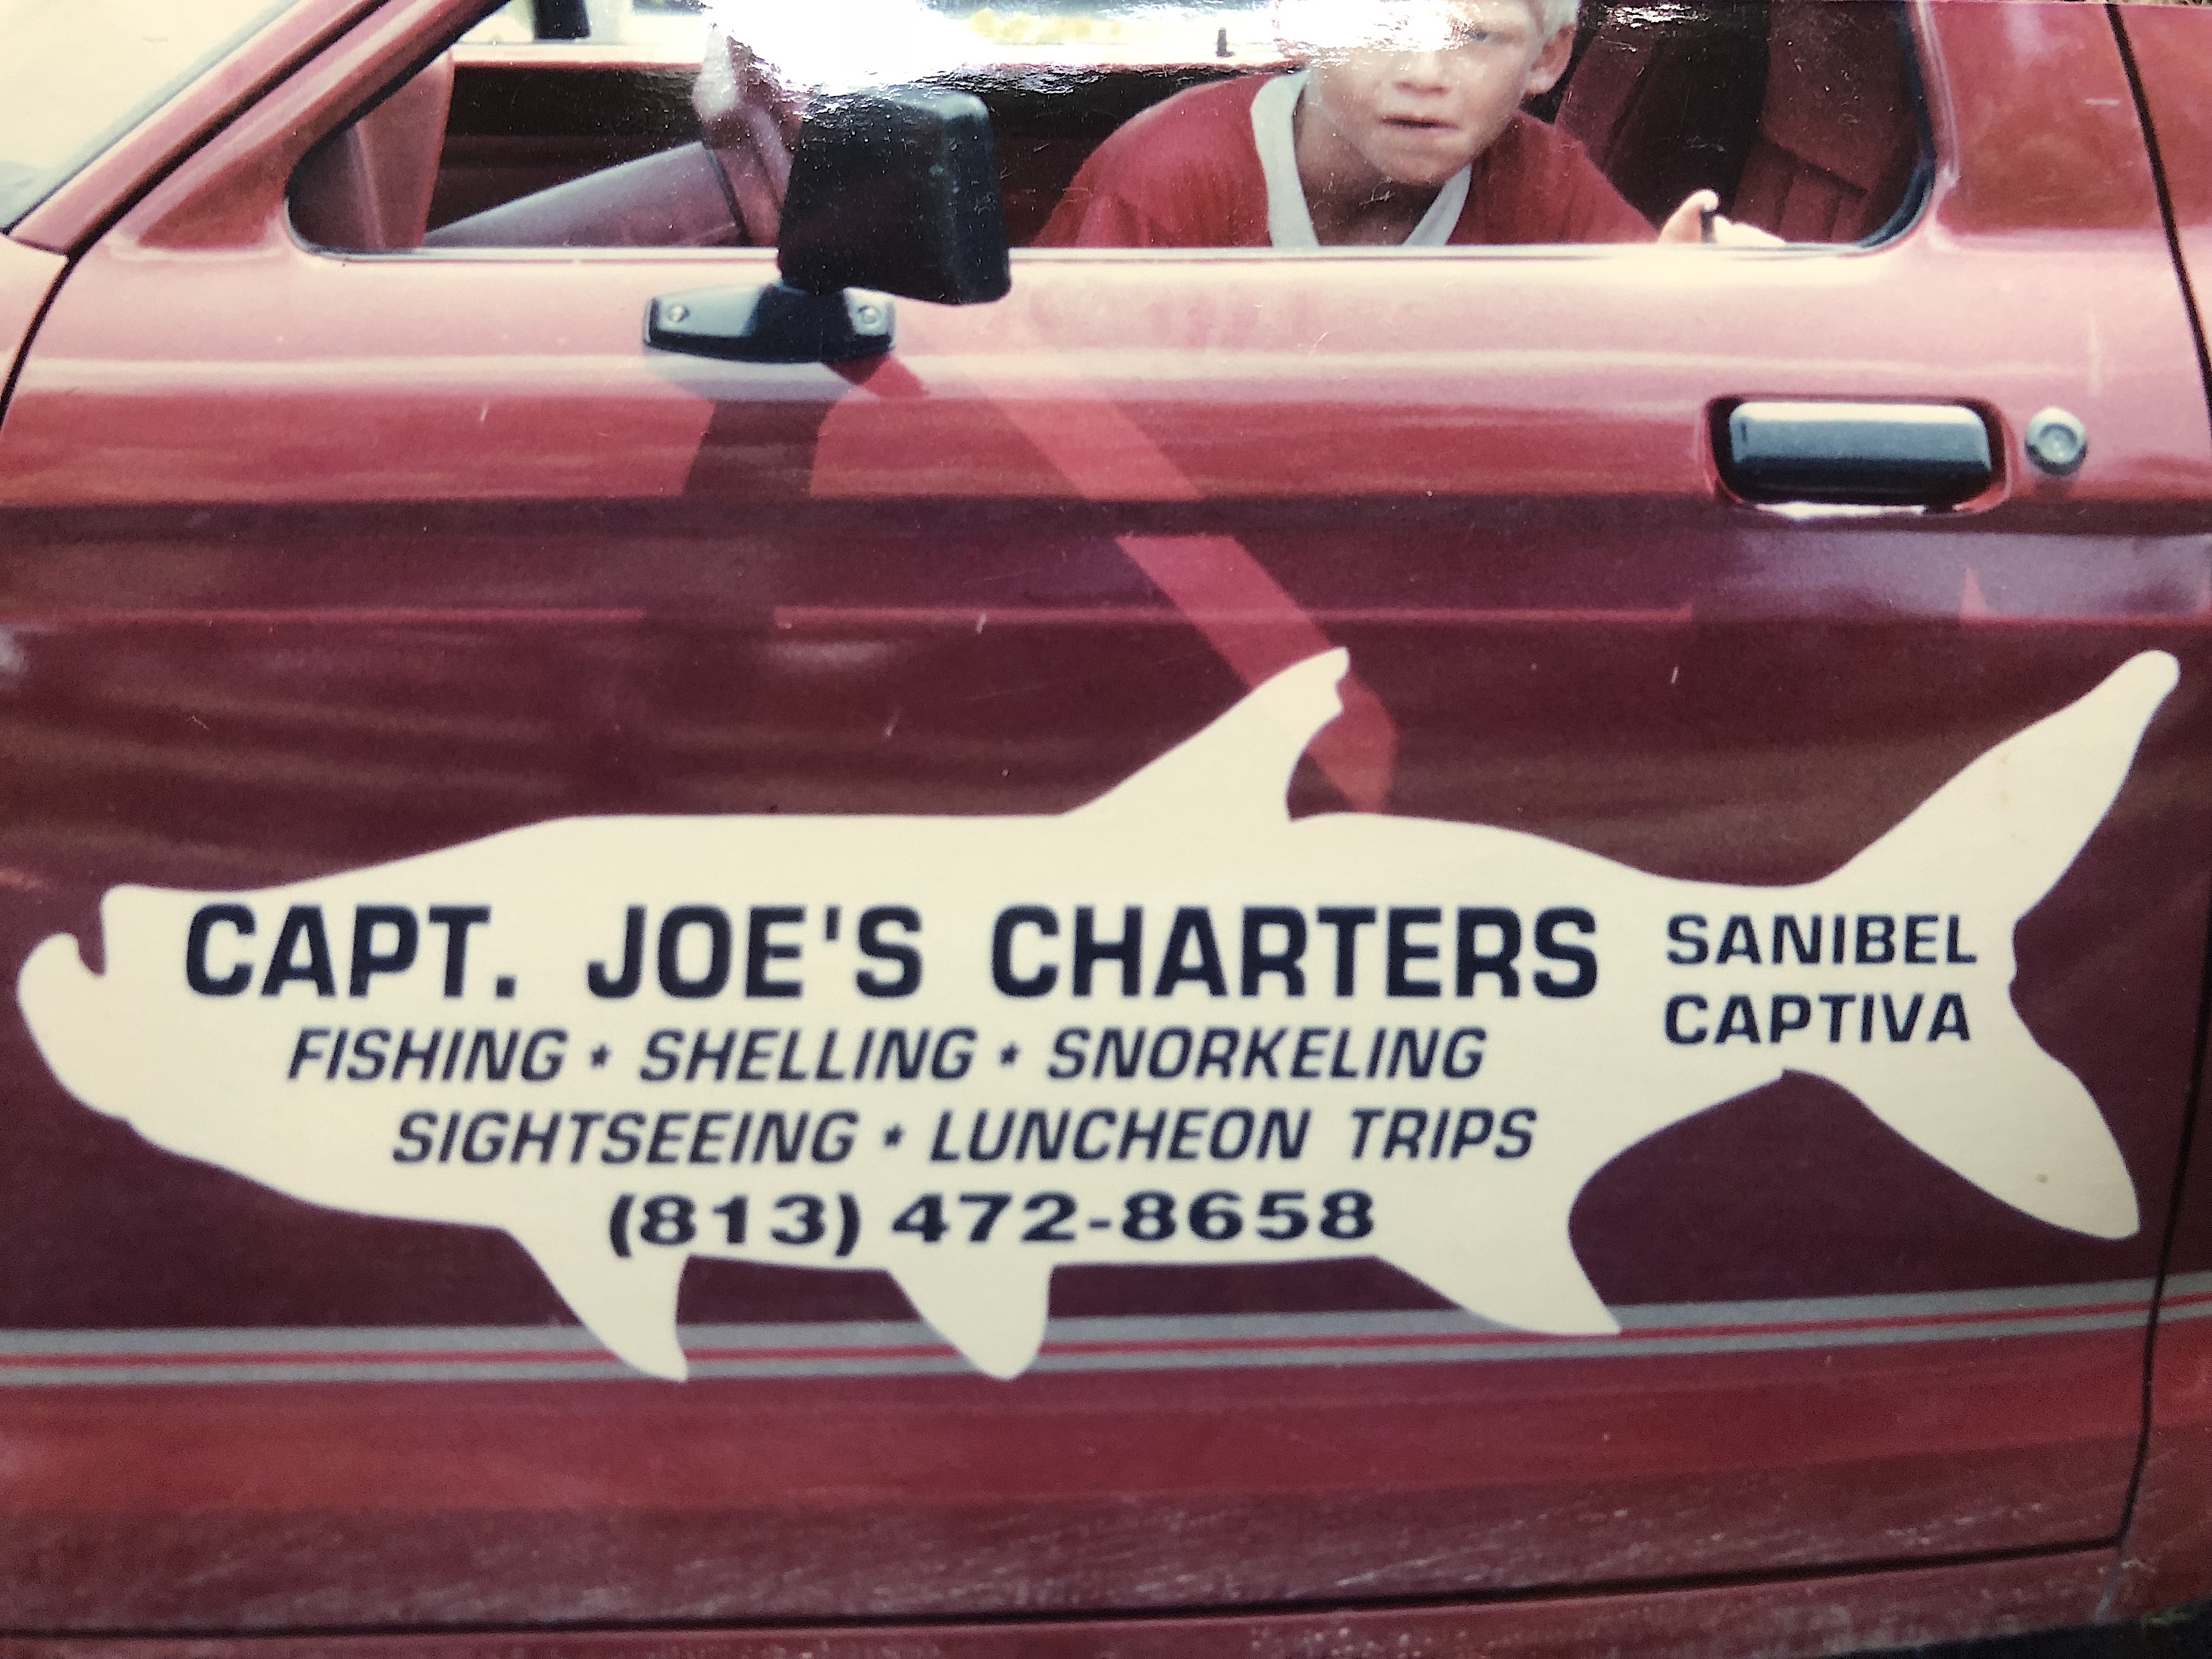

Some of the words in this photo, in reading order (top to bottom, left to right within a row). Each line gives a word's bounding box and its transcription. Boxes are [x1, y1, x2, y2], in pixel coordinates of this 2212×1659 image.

[184, 902, 517, 1000] CAPT.
[586, 904, 923, 1001] JOE'S
[989, 904, 1599, 1001] CHARTERS
[1666, 912, 1978, 967] SANIBEL
[1663, 991, 1971, 1047] CAPTIVA
[287, 1027, 569, 1083] FISHING
[639, 1026, 978, 1083] SHELLING
[1046, 1025, 1488, 1081] SNORKELING
[392, 1109, 860, 1166] SIGHTSEEING
[929, 1107, 1312, 1164] LUNCHEON
[1351, 1107, 1538, 1161] TRIPS
[607, 1192, 862, 1260] (813)
[890, 1187, 1375, 1245] 472-8658
